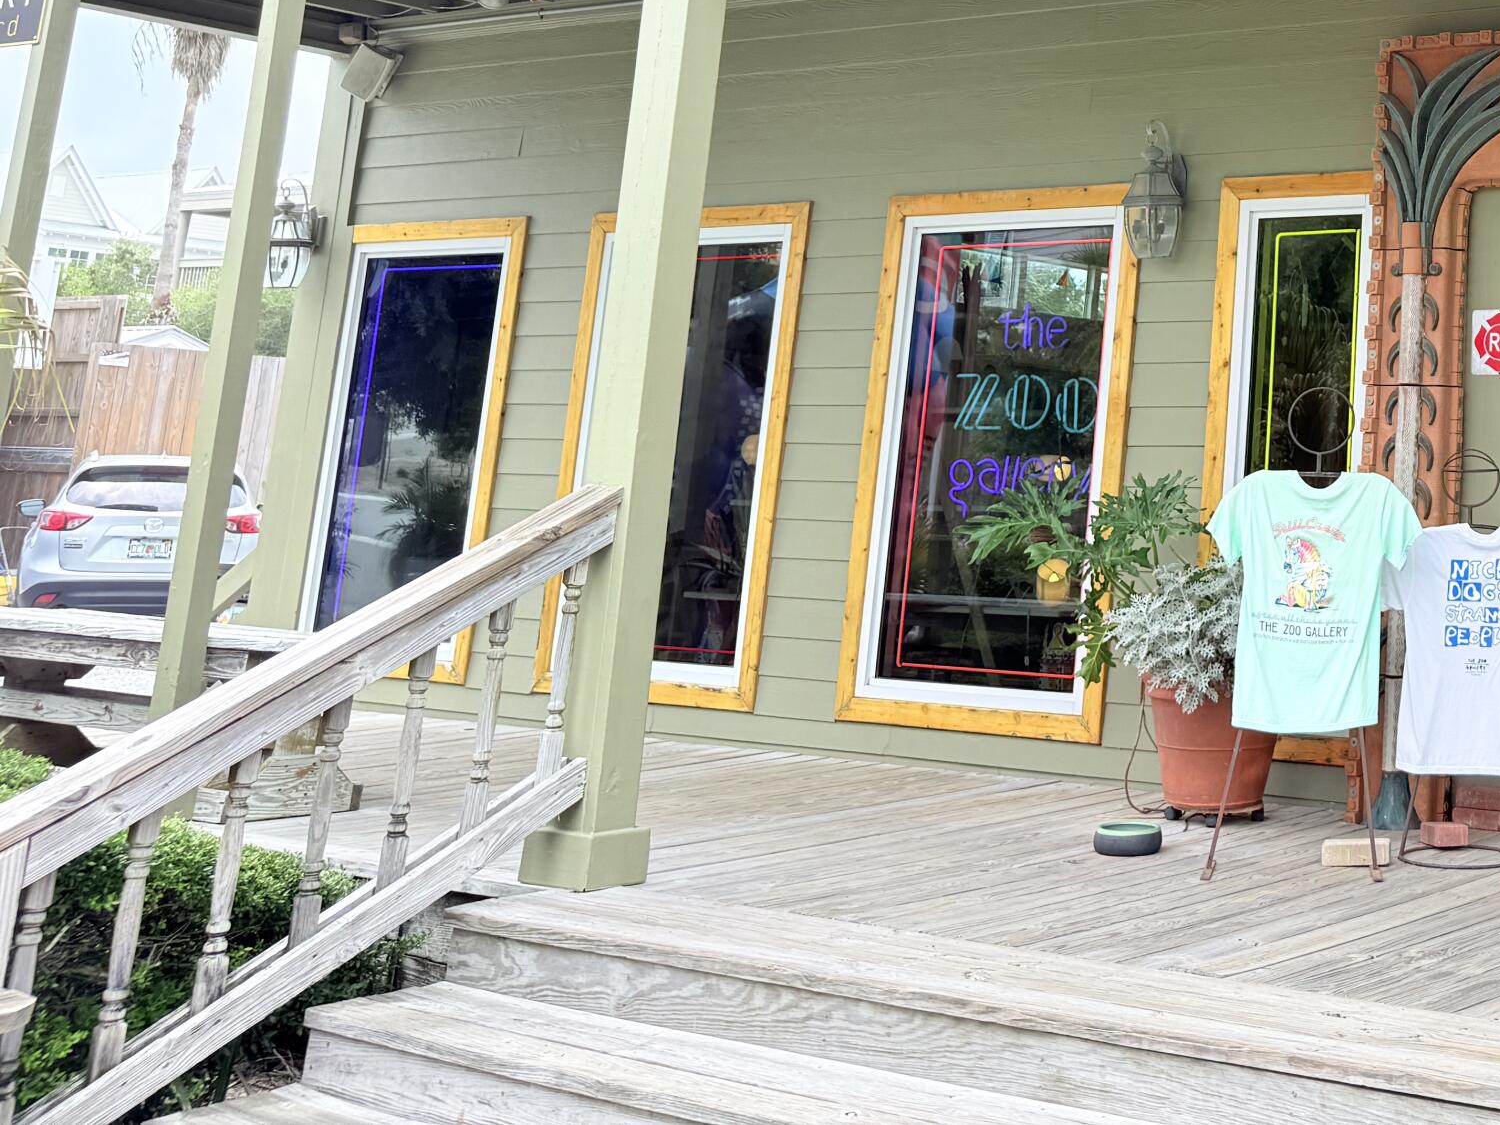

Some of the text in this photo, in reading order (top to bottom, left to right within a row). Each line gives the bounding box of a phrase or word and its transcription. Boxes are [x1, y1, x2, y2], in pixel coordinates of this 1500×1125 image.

[997, 302, 1070, 350] the
[1259, 620, 1278, 633] THE
[1283, 623, 1302, 636] ZOO
[1305, 626, 1349, 638] GALLERY
